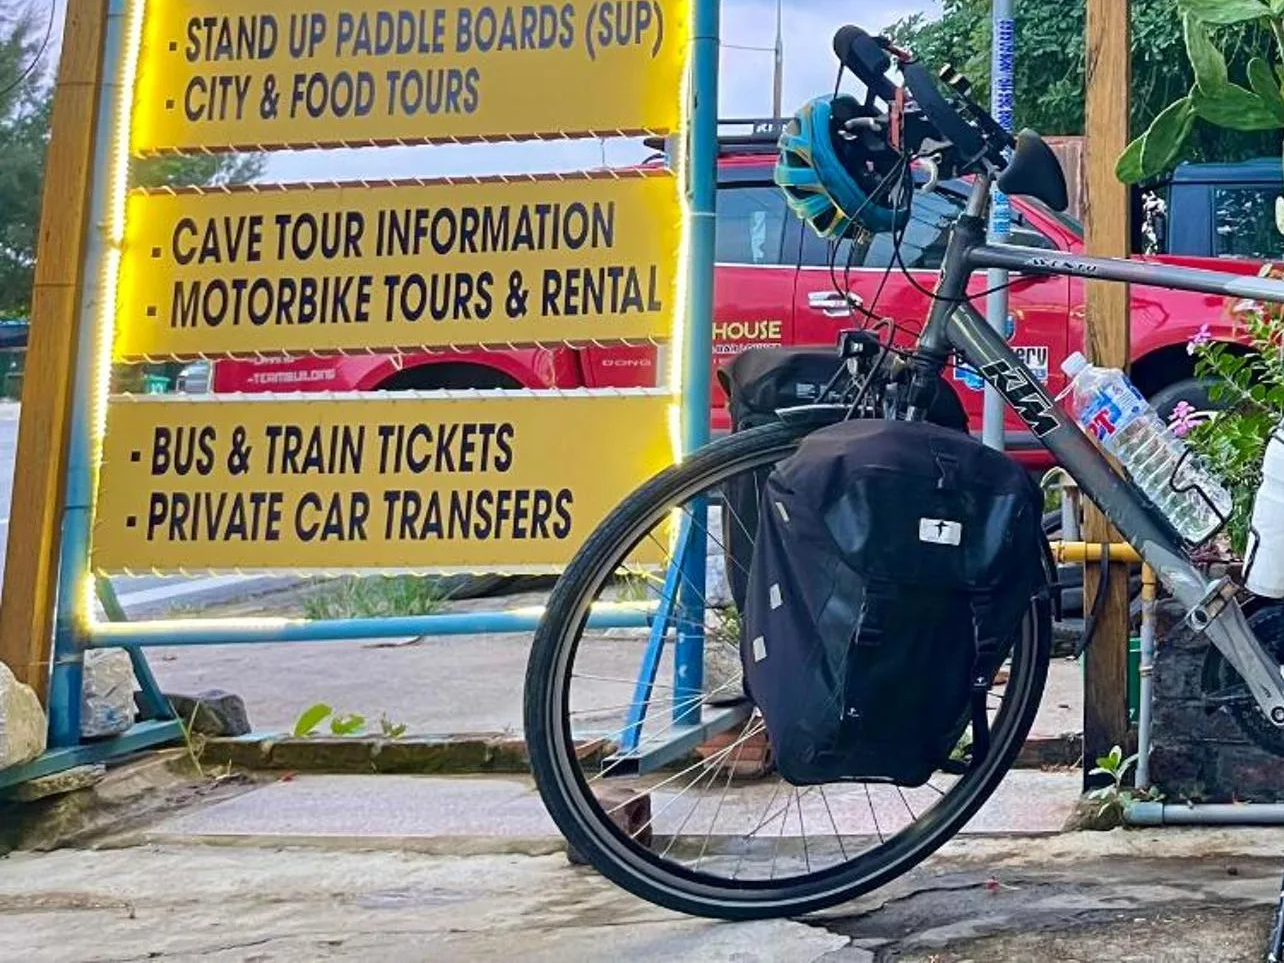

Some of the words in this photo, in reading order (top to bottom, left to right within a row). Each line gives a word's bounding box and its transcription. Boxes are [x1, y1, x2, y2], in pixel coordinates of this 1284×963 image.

[185, 14, 278, 63] STAND
[289, 11, 325, 58] UP
[335, 7, 446, 57] PADDLE
[455, 2, 576, 53] BOARDS
[585, 0, 664, 61] (SUP)
[184, 75, 251, 122] CITY
[260, 73, 281, 119] &
[289, 69, 376, 119] FOOD
[387, 66, 480, 116] TOURS
[171, 215, 262, 265] CAVE
[274, 209, 366, 260] TOUR
[375, 200, 616, 256] INFORMATION
[170, 275, 372, 328] MOTORBIKE
[384, 270, 493, 323] TOURS
[505, 269, 528, 318] &
[540, 264, 663, 317] RENTAL
[712, 320, 782, 340] HOUSE
[151, 425, 216, 476] BUS
[227, 425, 252, 476] &
[265, 423, 366, 475] TRAIN
[378, 422, 514, 474] TICKETS
[147, 490, 283, 542] PRIVATE
[294, 490, 370, 542] CAR
[383, 488, 573, 541] TRANSFERS
